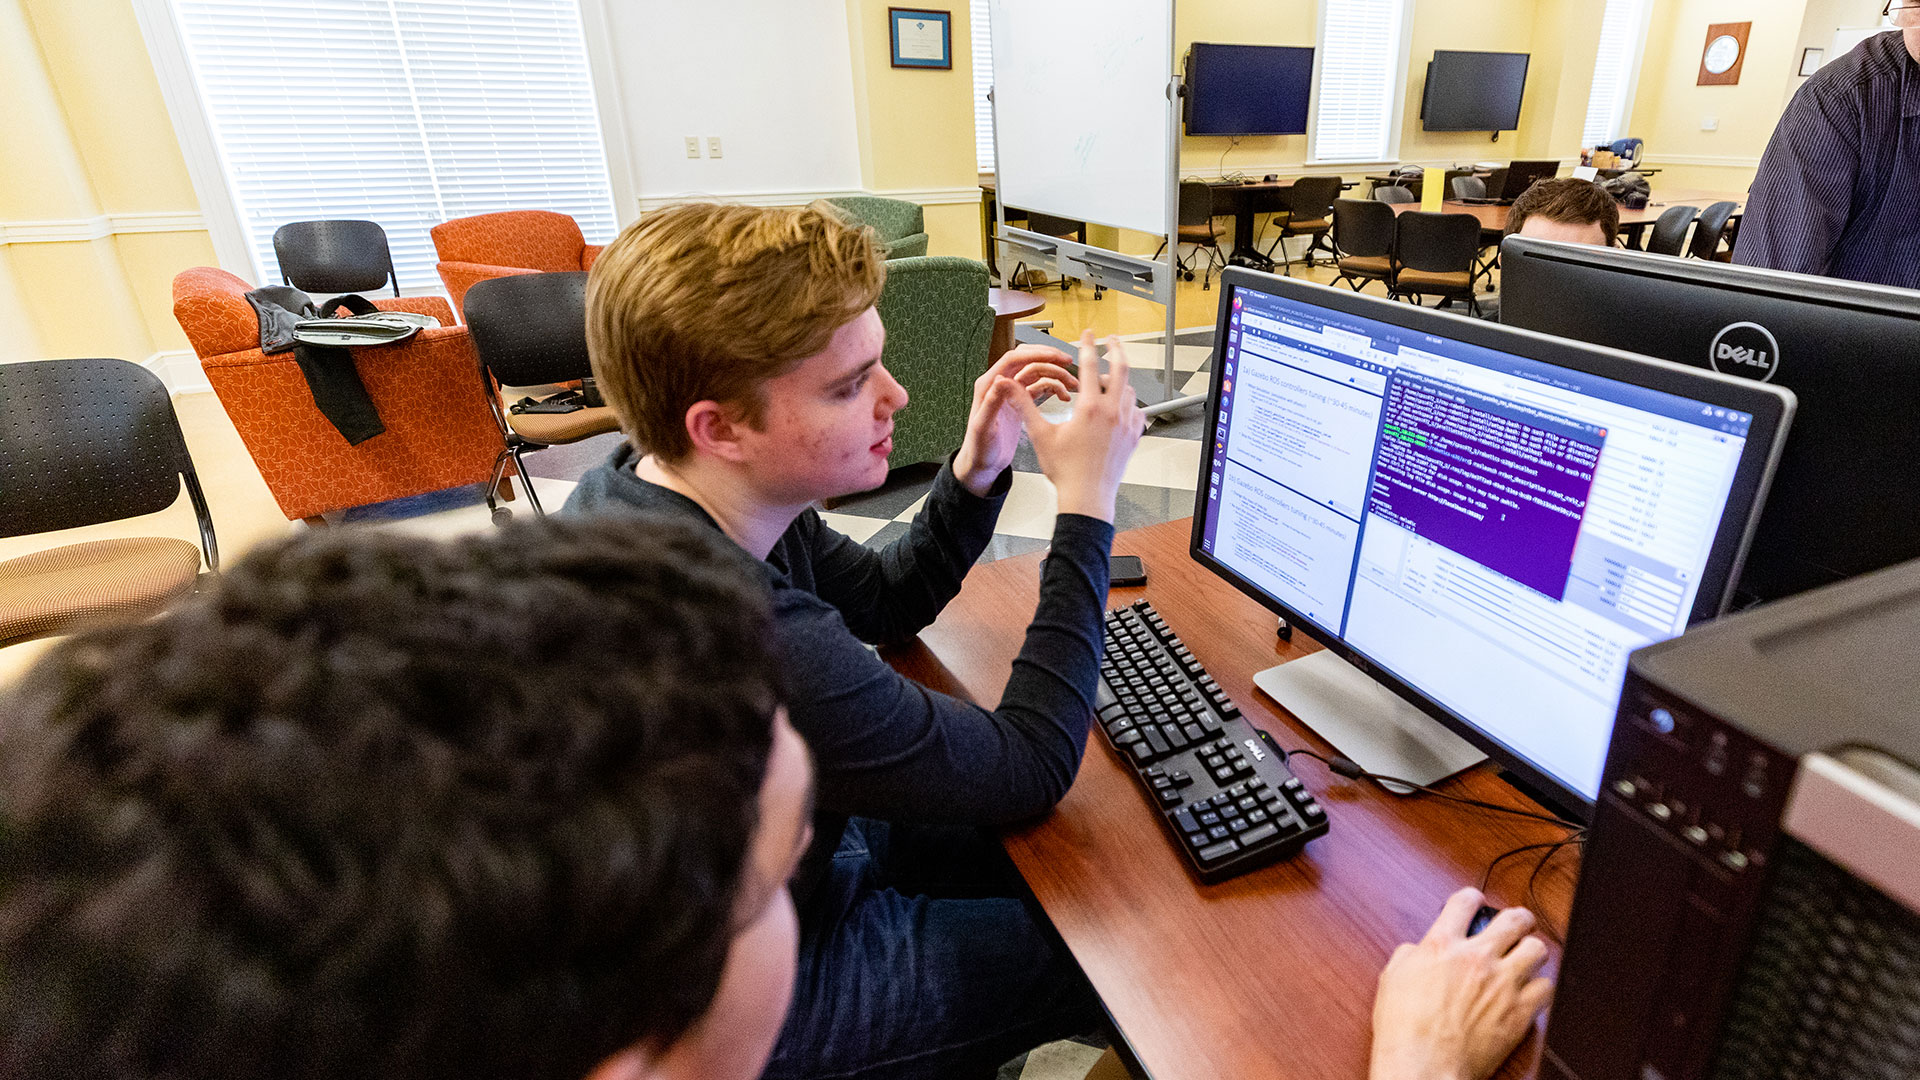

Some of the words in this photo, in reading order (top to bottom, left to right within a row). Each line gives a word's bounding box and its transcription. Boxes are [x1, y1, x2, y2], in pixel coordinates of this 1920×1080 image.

[1717, 343, 1769, 369] DELL
[1269, 374, 1280, 385] ROS
[1280, 378, 1308, 395] controllers
[1307, 388, 1326, 403] tuning
[1264, 491, 1290, 510] controllers
[1290, 504, 1307, 520] tuning
[1244, 739, 1266, 762] DELL
